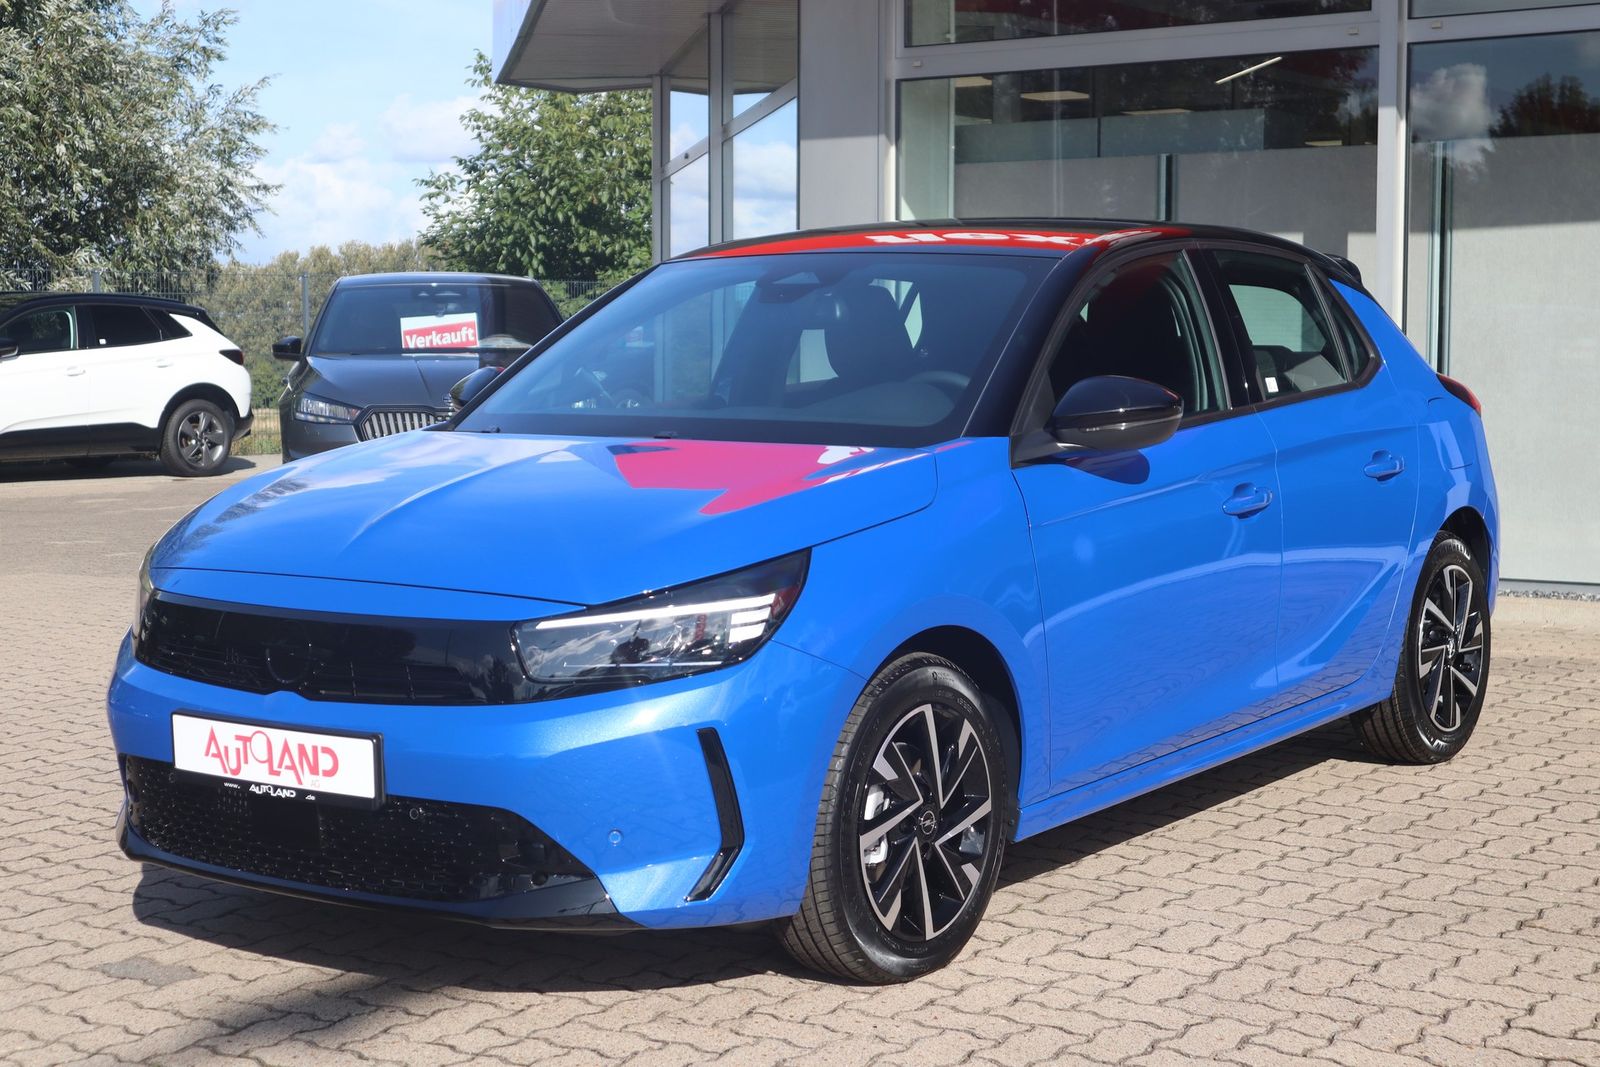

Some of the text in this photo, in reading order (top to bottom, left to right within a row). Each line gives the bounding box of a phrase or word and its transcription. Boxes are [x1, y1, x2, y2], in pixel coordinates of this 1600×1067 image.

[405, 326, 475, 348] Verkauft
[204, 725, 339, 785] AUTOLAND
[249, 784, 296, 798] AUTOLAND
